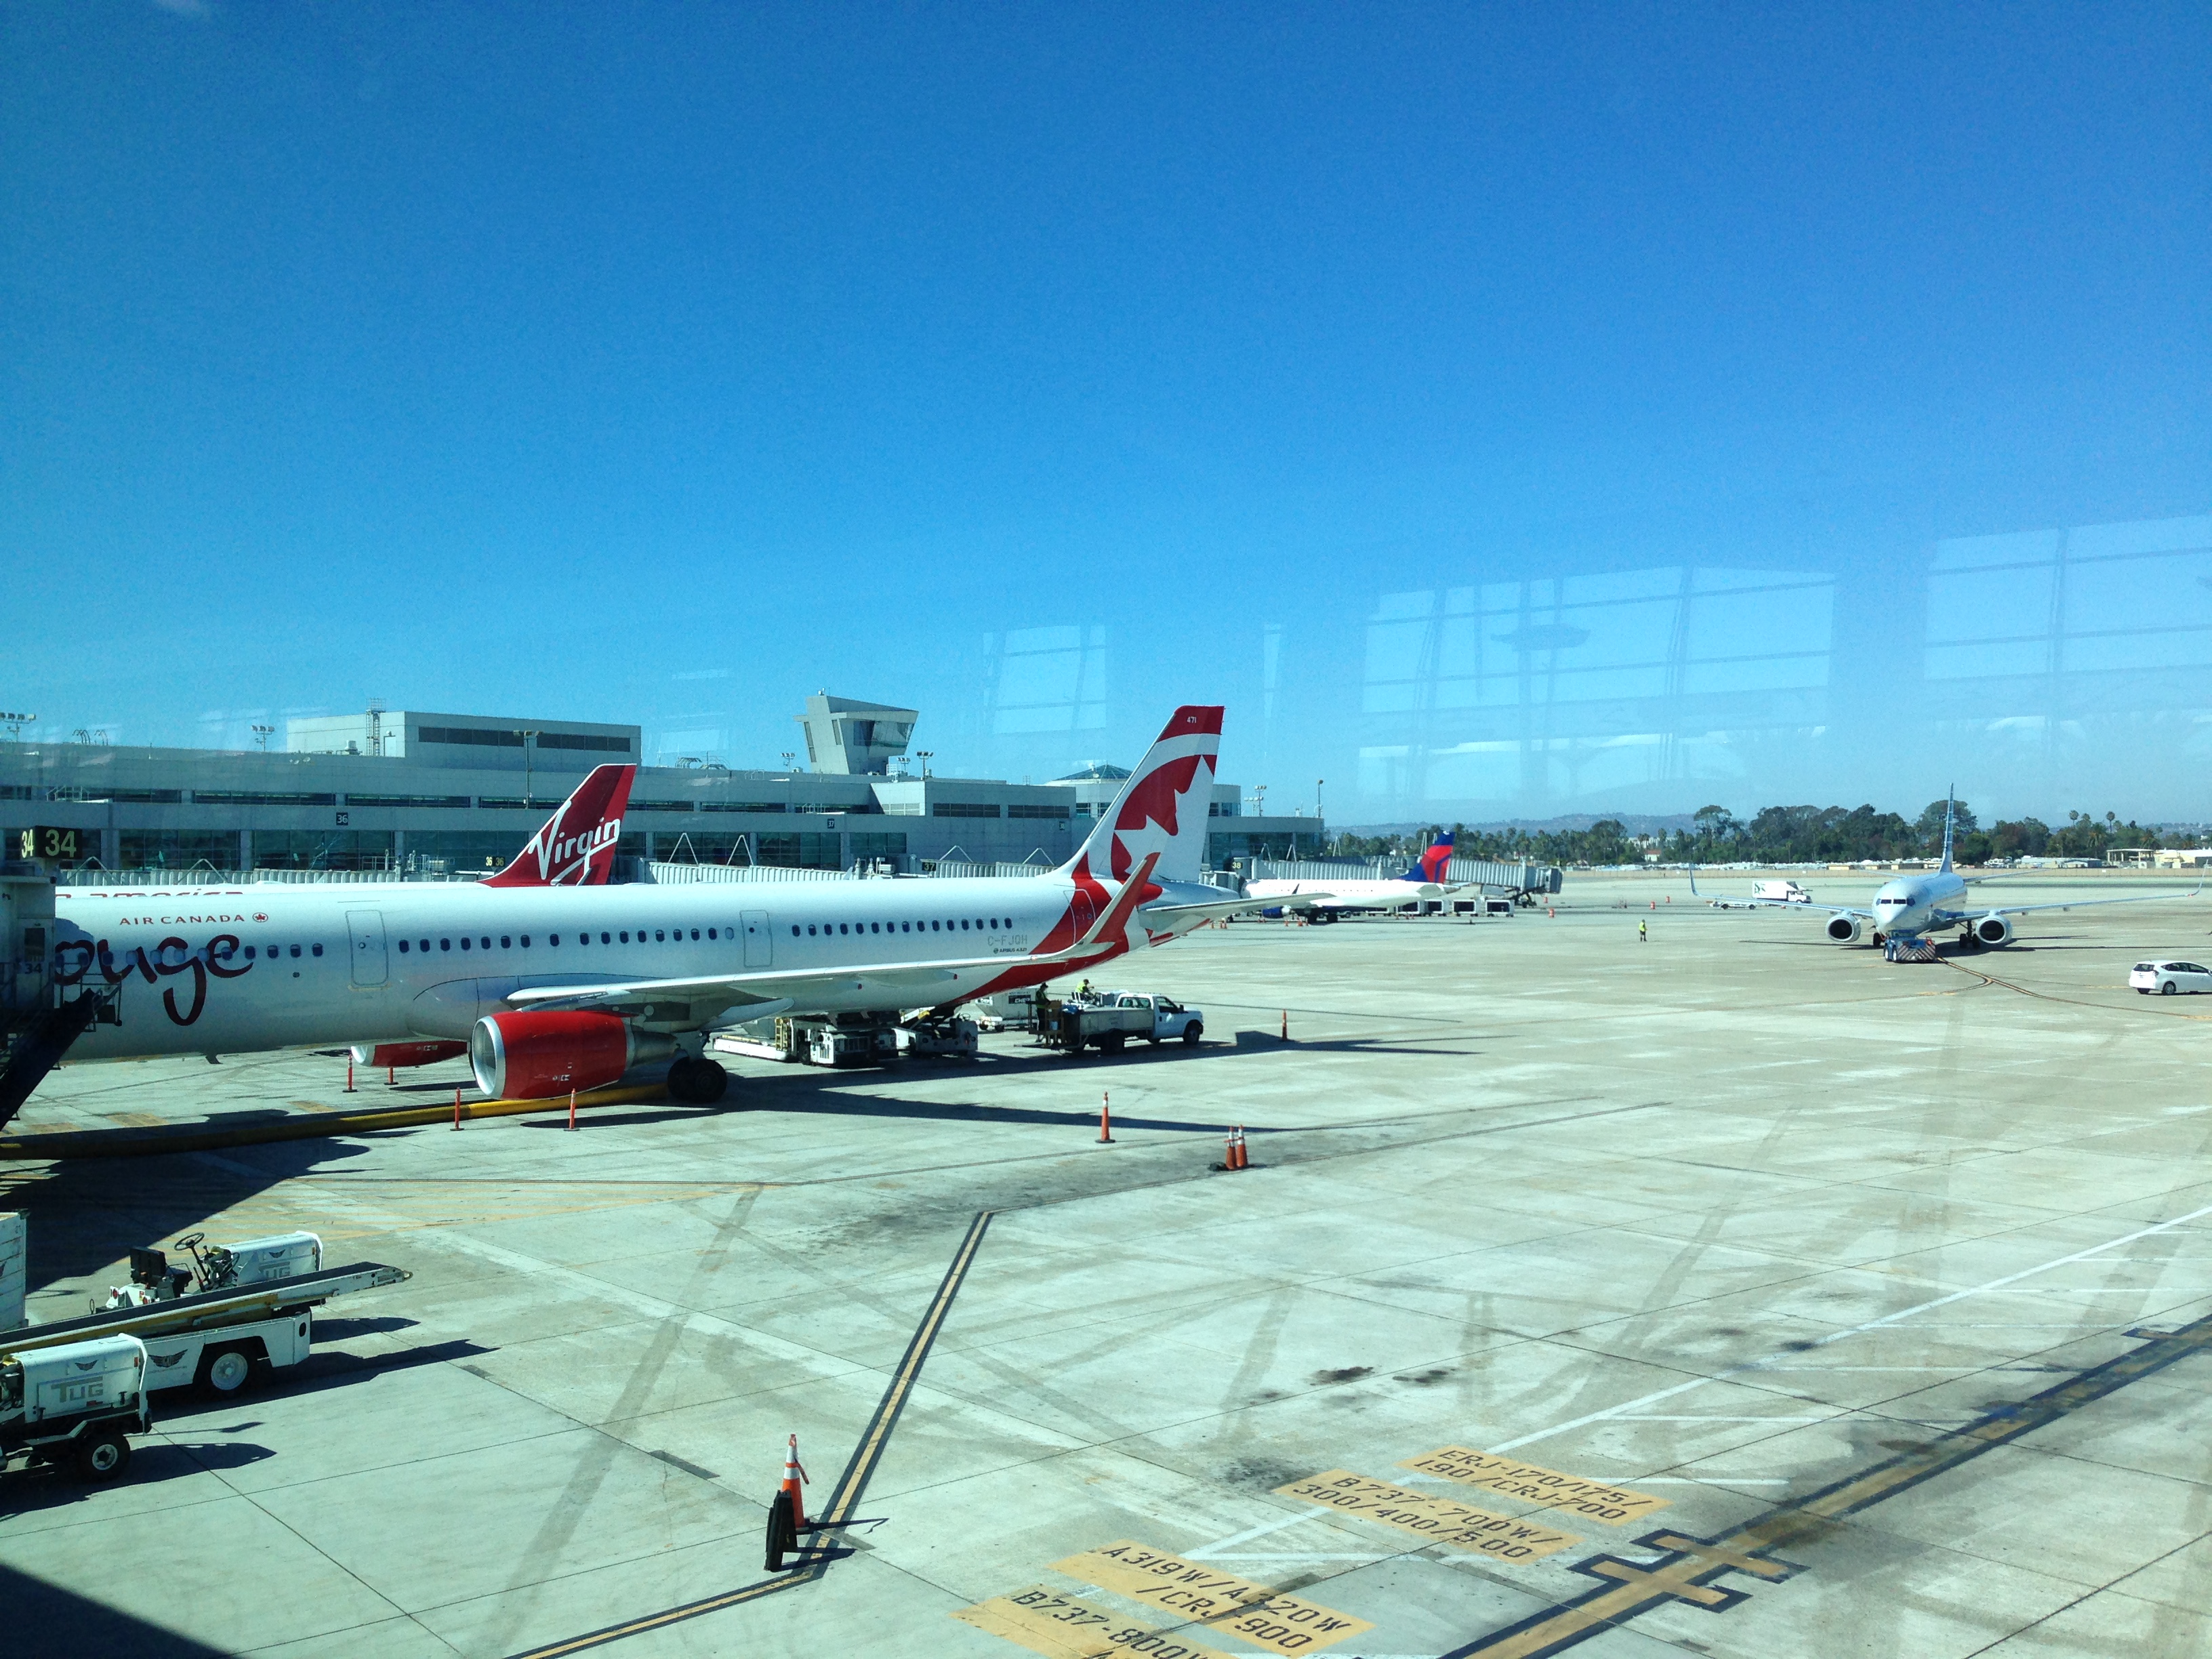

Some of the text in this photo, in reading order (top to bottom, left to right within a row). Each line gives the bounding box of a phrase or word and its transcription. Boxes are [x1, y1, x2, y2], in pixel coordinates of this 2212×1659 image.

[1187, 716, 1197, 724] 471
[336, 814, 348, 823] 36
[21, 828, 34, 859] 34
[45, 829, 77, 858] 34
[527, 800, 621, 886] Virgin
[495, 857, 504, 866] 36
[924, 863, 935, 871] 37
[119, 914, 245, 926] AIR CANADA
[24, 963, 43, 975] 34
[55, 934, 254, 1026] ouge
[50, 1376, 103, 1403] TUG
[1414, 1459, 1475, 1478] 190
